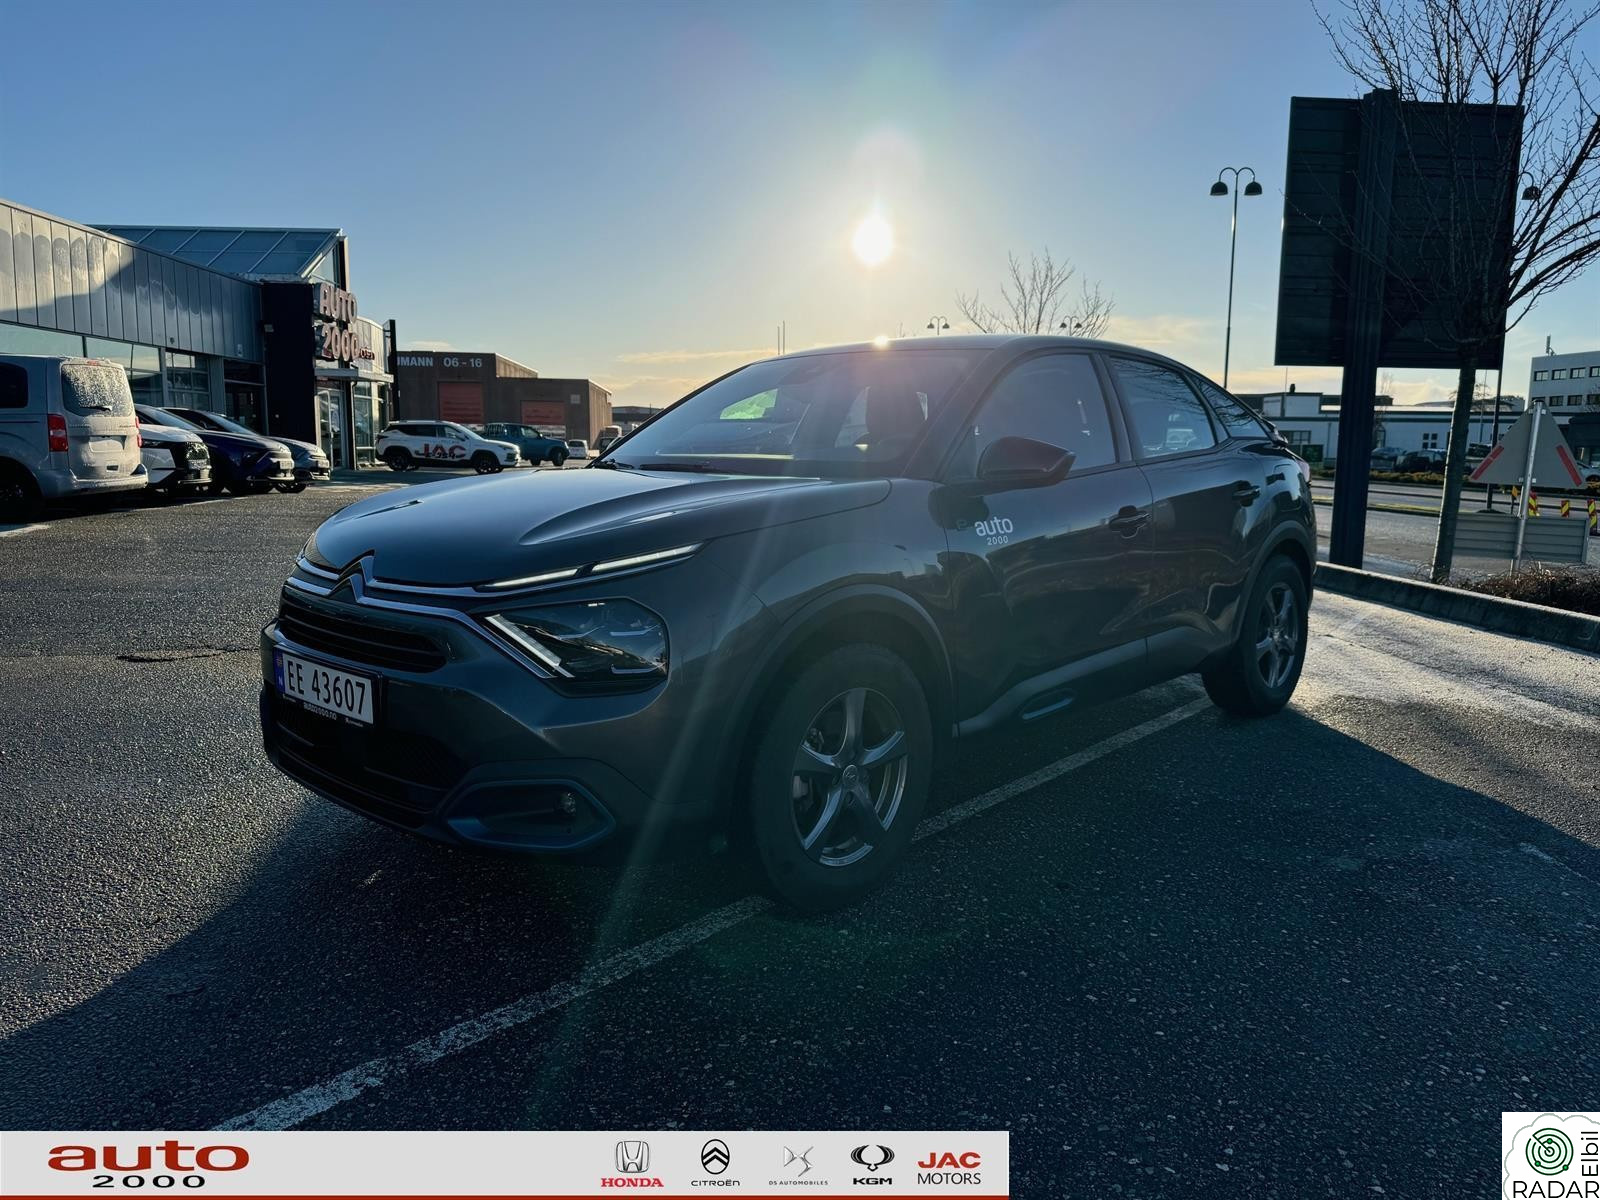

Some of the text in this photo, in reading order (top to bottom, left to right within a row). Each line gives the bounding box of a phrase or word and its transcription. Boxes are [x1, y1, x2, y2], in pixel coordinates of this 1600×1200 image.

[319, 283, 357, 324] AUTO
[321, 323, 359, 362] 2000
[443, 357, 459, 368] 06
[470, 357, 482, 368] 16
[415, 443, 466, 458] JAC
[974, 516, 1014, 537] auto
[986, 535, 1009, 546] 2000
[288, 661, 365, 714] EE 43607
